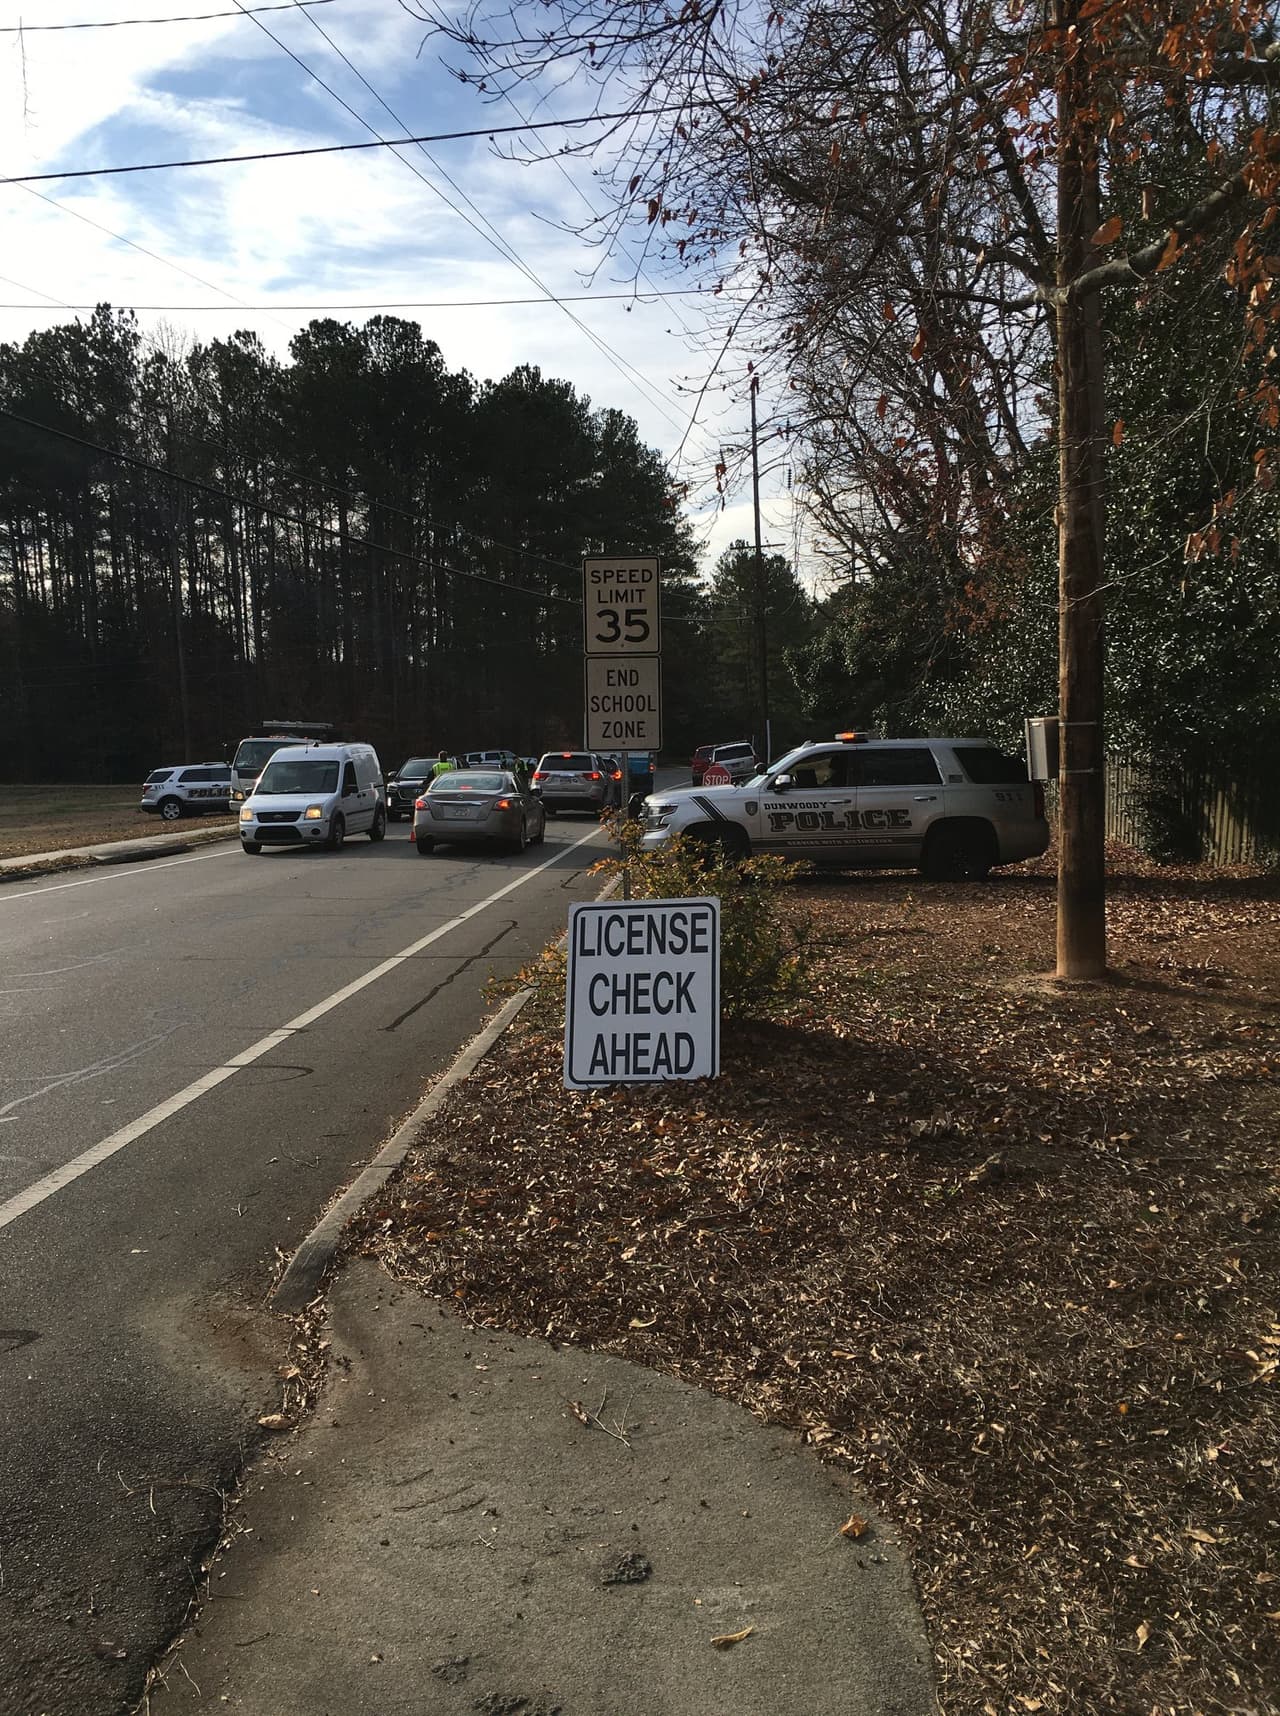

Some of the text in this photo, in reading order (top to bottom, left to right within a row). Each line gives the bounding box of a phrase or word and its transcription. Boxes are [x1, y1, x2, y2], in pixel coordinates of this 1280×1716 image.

[590, 569, 653, 584] SPEED
[597, 589, 646, 604] LIMIT
[595, 609, 650, 643] 35
[607, 669, 639, 687] END
[590, 695, 656, 713] SCHOOL
[602, 721, 646, 738] ZONE
[705, 775, 729, 786] STOP
[764, 801, 828, 810] DUNWOODY
[768, 808, 913, 833] POLICE
[579, 912, 709, 957] LICENSE
[588, 971, 697, 1017] CHECK
[588, 1032, 696, 1076] AHEAD
